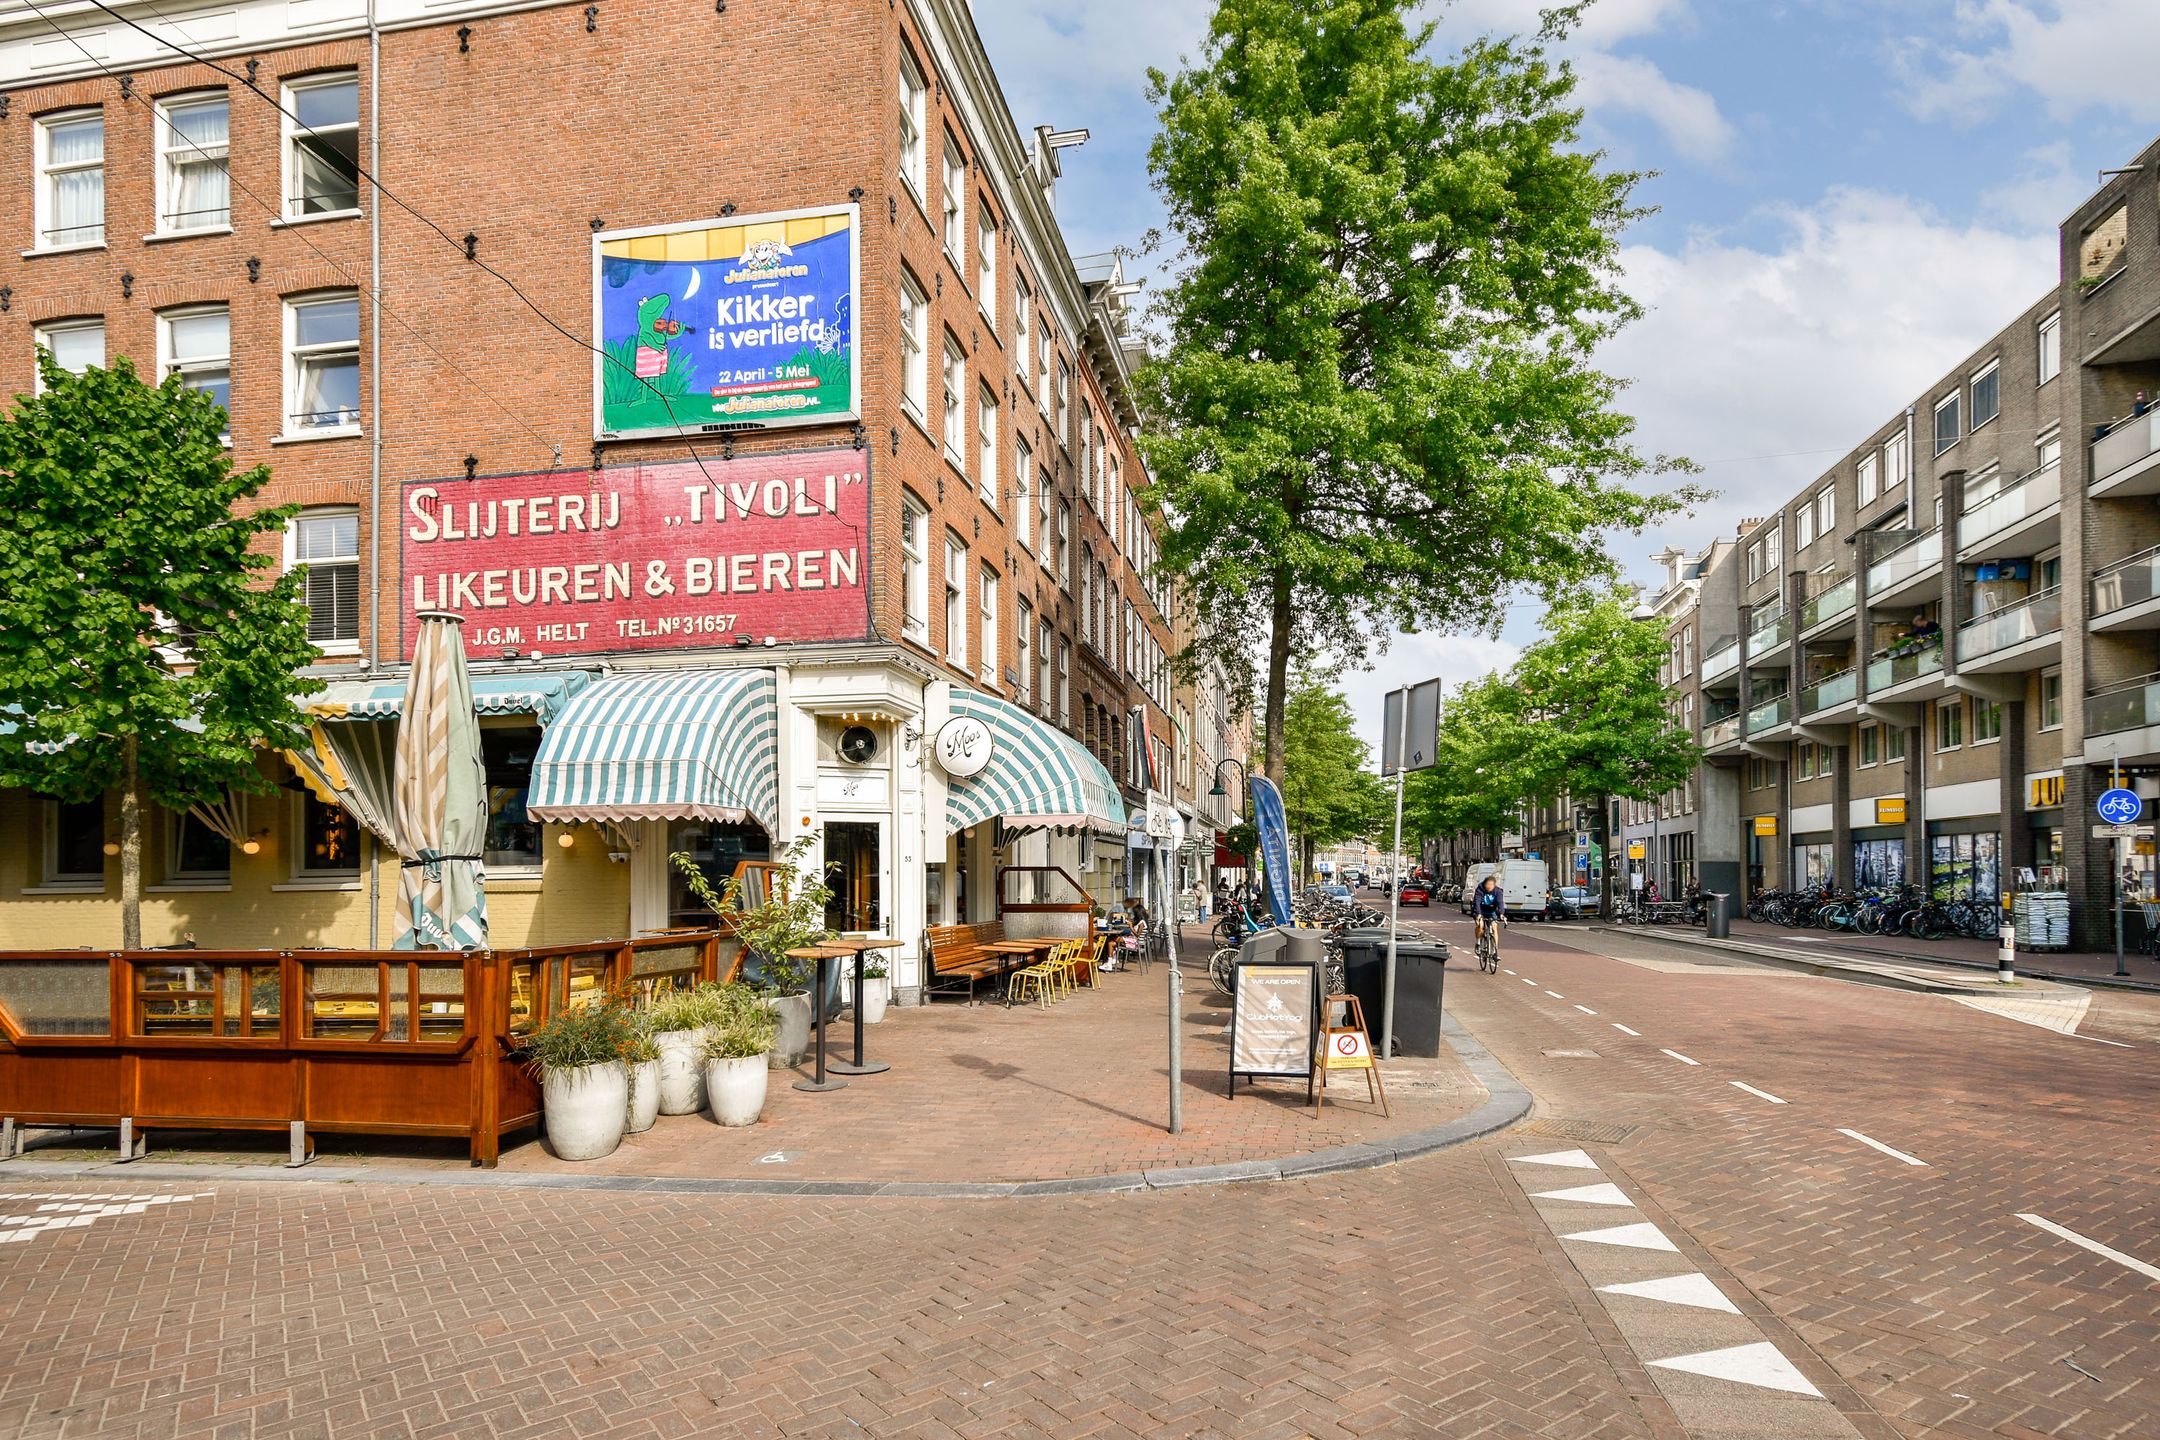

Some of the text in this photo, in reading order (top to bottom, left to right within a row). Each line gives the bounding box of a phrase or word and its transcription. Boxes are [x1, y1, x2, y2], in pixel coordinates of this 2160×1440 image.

[717, 294, 815, 326] Kikker
[709, 318, 825, 350] is verliefd
[734, 367, 765, 384] April
[775, 366, 783, 378] 5
[786, 364, 810, 378] Mei
[408, 486, 620, 543] SLIJTERIJ
[413, 547, 860, 611] LIKEUREN & BIEREN
[472, 626, 526, 645] J.G.M.
[537, 622, 590, 642] HELT
[683, 614, 738, 634] 31657
